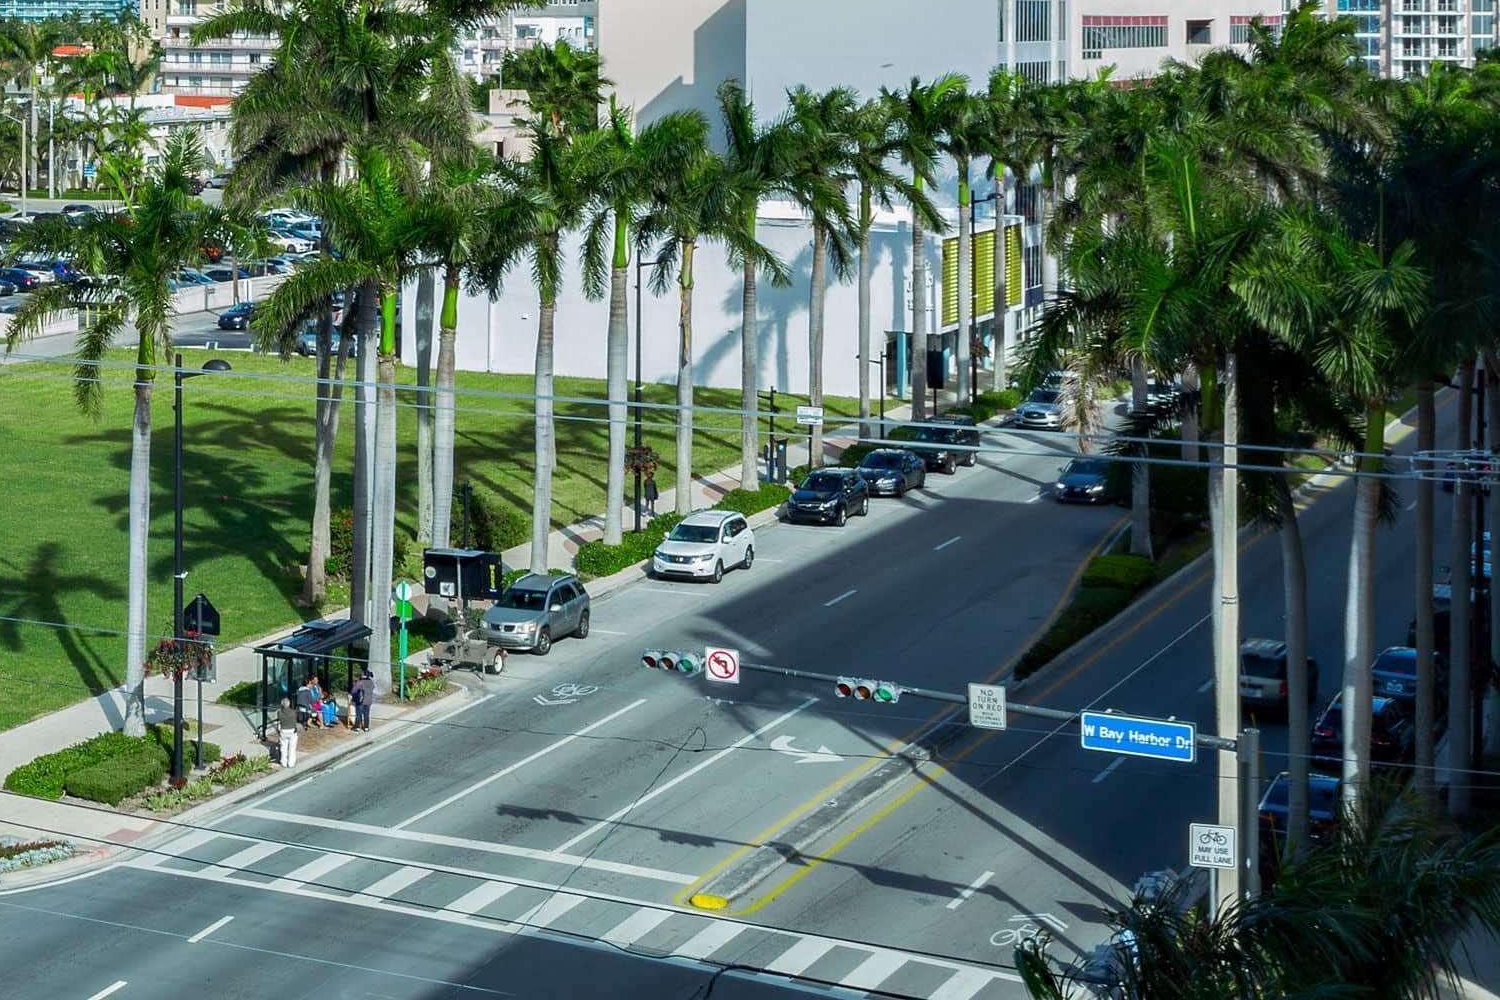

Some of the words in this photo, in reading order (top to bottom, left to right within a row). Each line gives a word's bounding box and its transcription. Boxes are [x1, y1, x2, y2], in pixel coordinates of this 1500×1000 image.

[980, 689, 994, 697] NO
[977, 695, 998, 704] TURN
[972, 702, 984, 710] ON
[986, 704, 1002, 712] RED
[1084, 725, 1095, 736] W
[1100, 727, 1124, 743] Bay
[1129, 730, 1171, 747] Harbor
[1176, 736, 1191, 749] Dr
[1194, 855, 1211, 863] FULL
[1213, 857, 1232, 865] LANE
